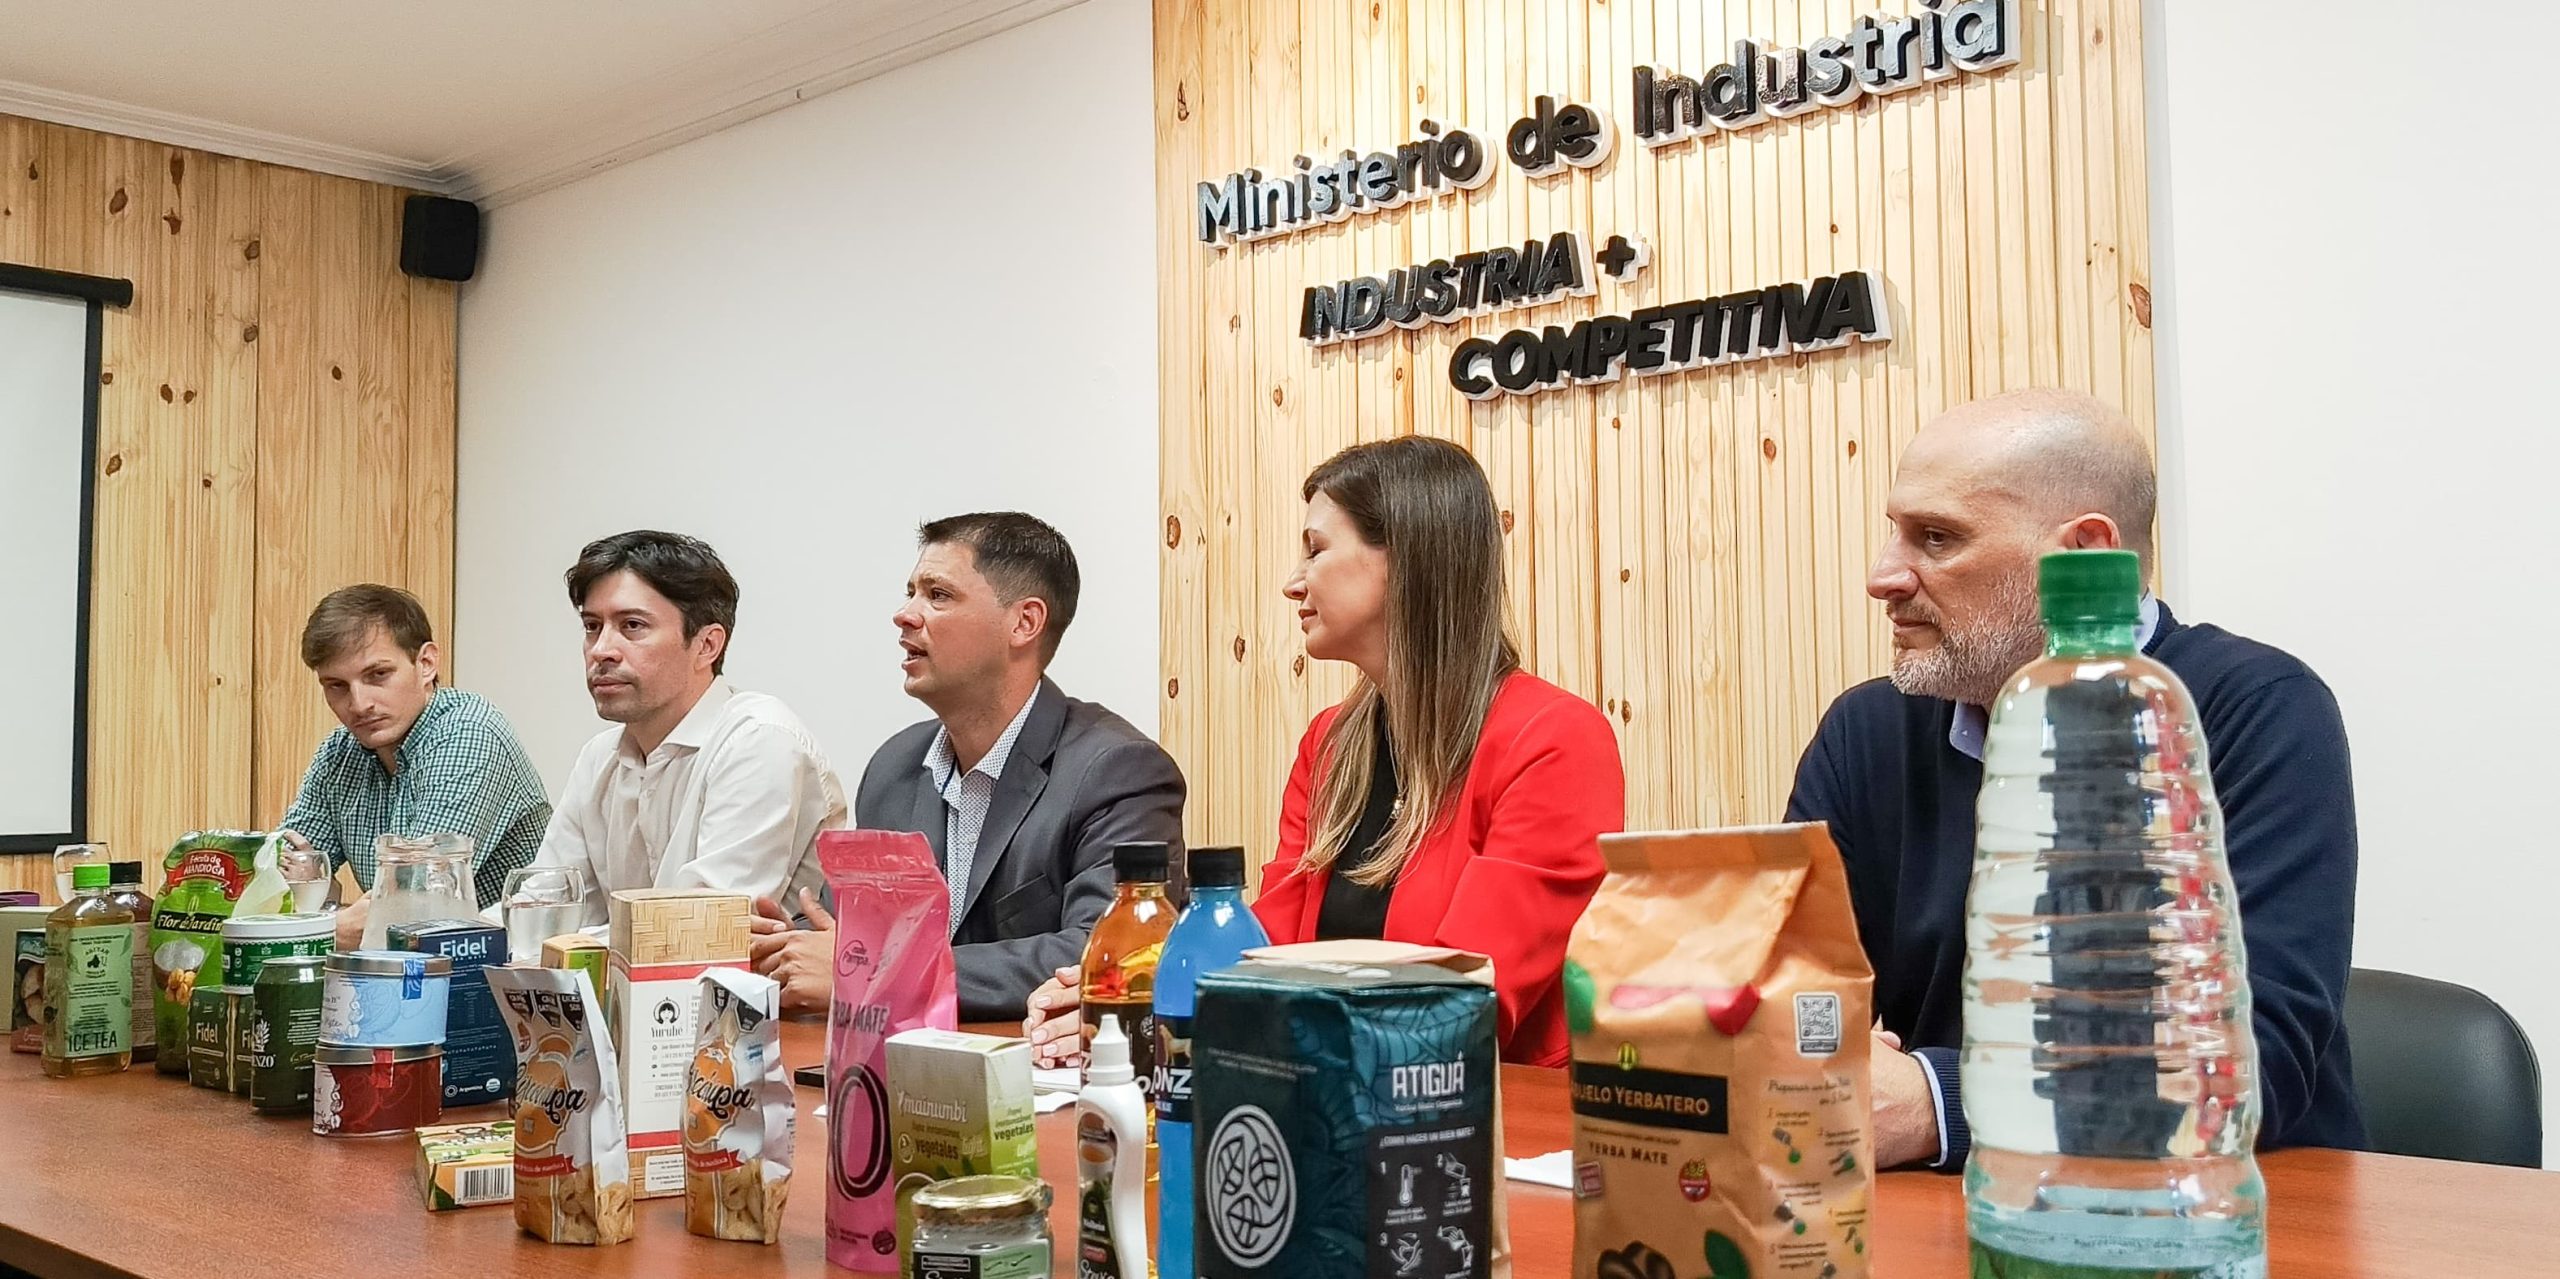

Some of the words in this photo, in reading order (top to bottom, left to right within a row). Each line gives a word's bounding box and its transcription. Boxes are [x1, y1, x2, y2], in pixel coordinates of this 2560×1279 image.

[1197, 117, 1488, 244] Ministerio
[1507, 94, 1607, 172] de
[1632, 0, 2010, 140] Industria
[1300, 230, 1592, 340] INDUSTRIA
[1448, 269, 1880, 397] COMPETITIVA
[157, 914, 179, 929] Flor
[439, 936, 488, 958] Fidel
[853, 1004, 888, 1034] MATE
[69, 1032, 90, 1052] ICE
[94, 1030, 118, 1050] TEA
[195, 1022, 219, 1043] Fidel
[252, 1055, 275, 1068] NZO
[1392, 1050, 1465, 1099] ATIGUÁ
[1615, 1086, 1710, 1117] YERBATERO
[994, 1122, 1034, 1141] vegetales
[915, 1138, 959, 1160] vegetales
[1588, 1140, 1626, 1158] YERBA
[1631, 1147, 1668, 1165] MATE
